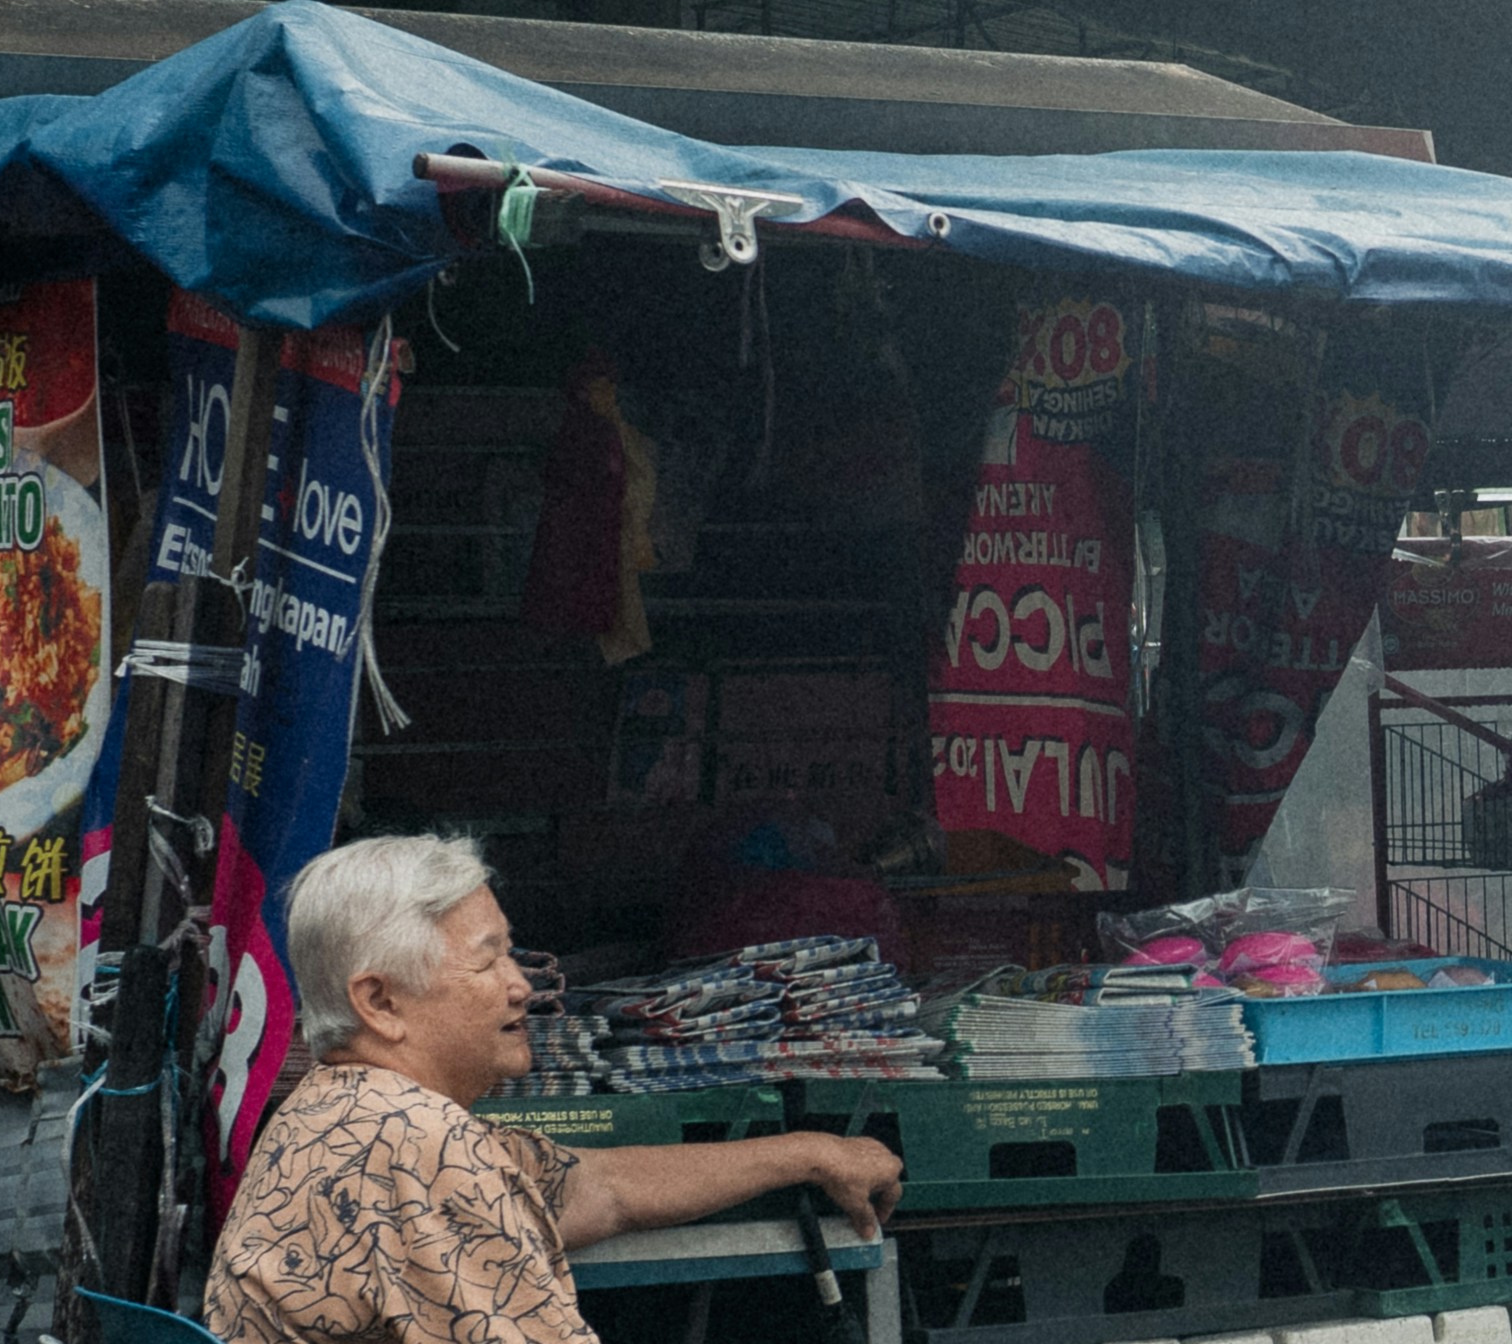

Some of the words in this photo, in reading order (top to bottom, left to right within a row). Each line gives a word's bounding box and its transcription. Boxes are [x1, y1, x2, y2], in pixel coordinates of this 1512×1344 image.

[292, 458, 363, 555] love
[248, 576, 355, 662] ngkapan
[1393, 588, 1475, 606] MASSIMO
[981, 735, 1131, 827] JULAI
